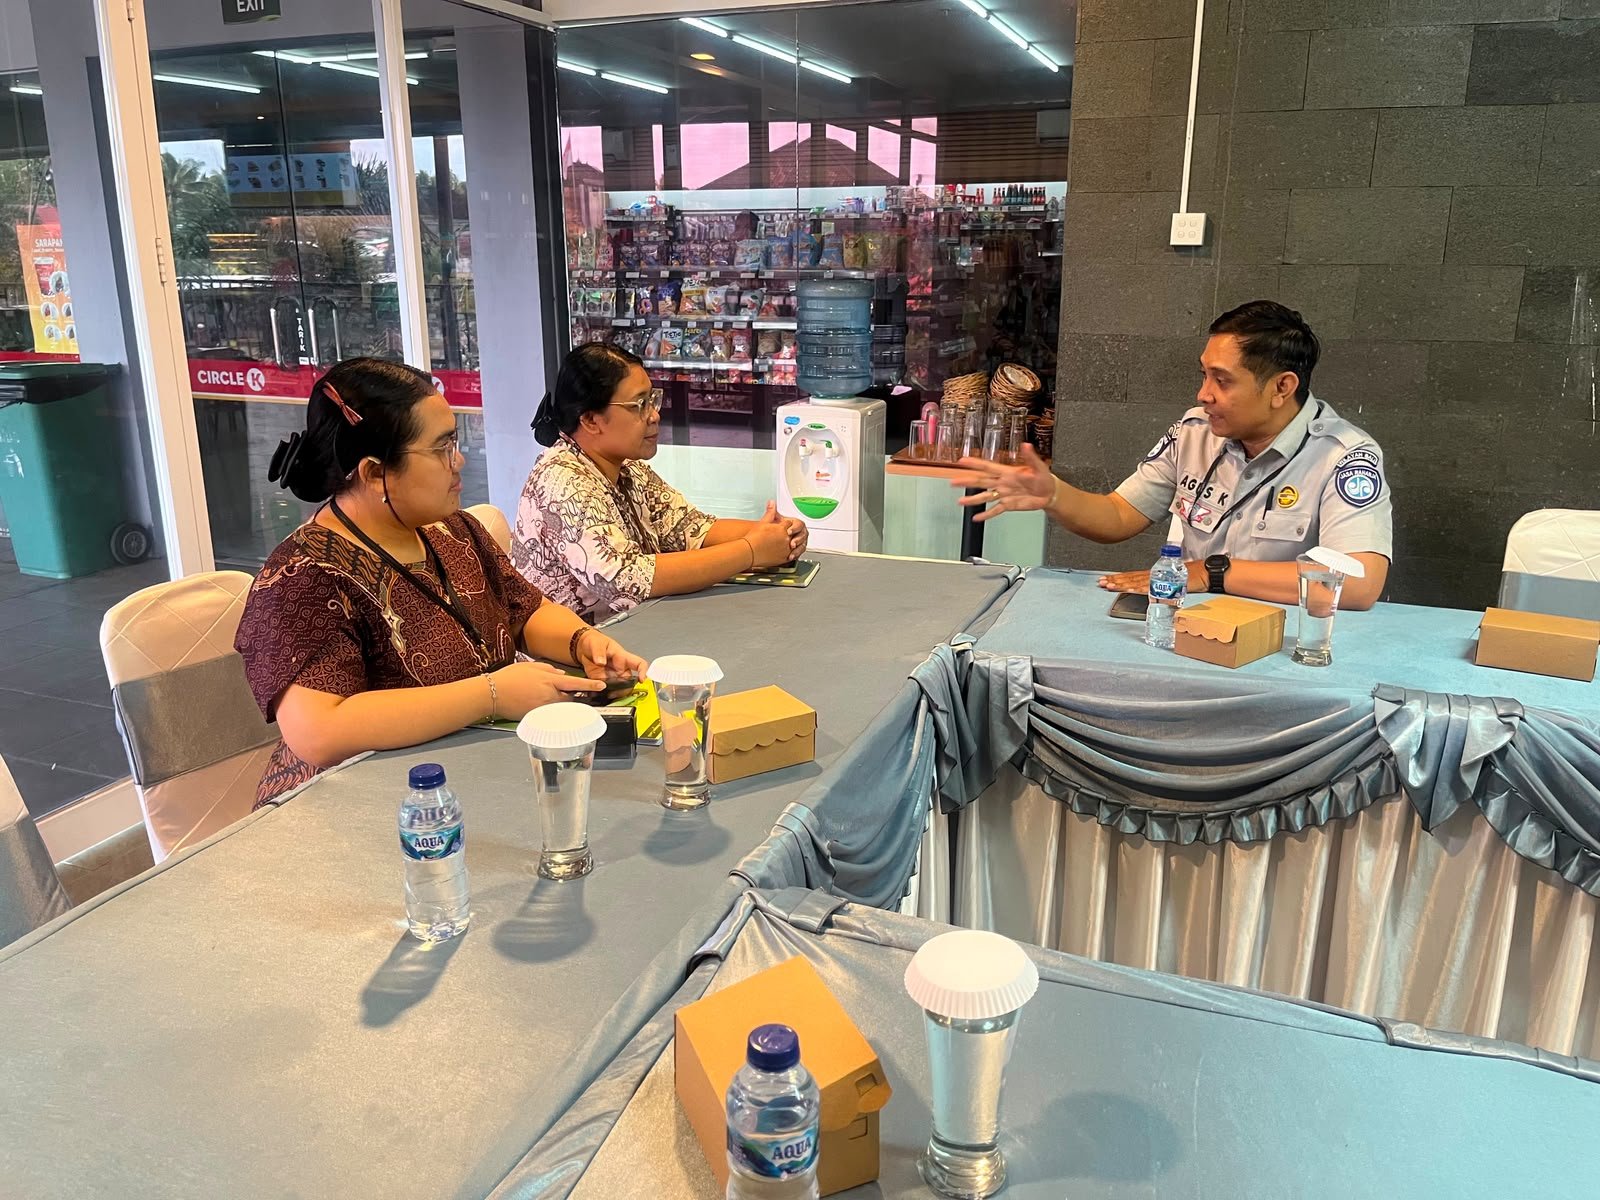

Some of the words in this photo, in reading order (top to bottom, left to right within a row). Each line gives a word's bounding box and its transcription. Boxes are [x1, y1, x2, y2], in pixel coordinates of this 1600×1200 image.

[296, 317, 306, 352] TARIK
[197, 370, 245, 386] CIRCLE
[248, 369, 265, 391] K
[1364, 452, 1378, 465] BALI
[1340, 470, 1353, 480] JASA
[1217, 492, 1229, 507] K
[414, 835, 445, 849] AQUA
[771, 1136, 812, 1161] AQUA
